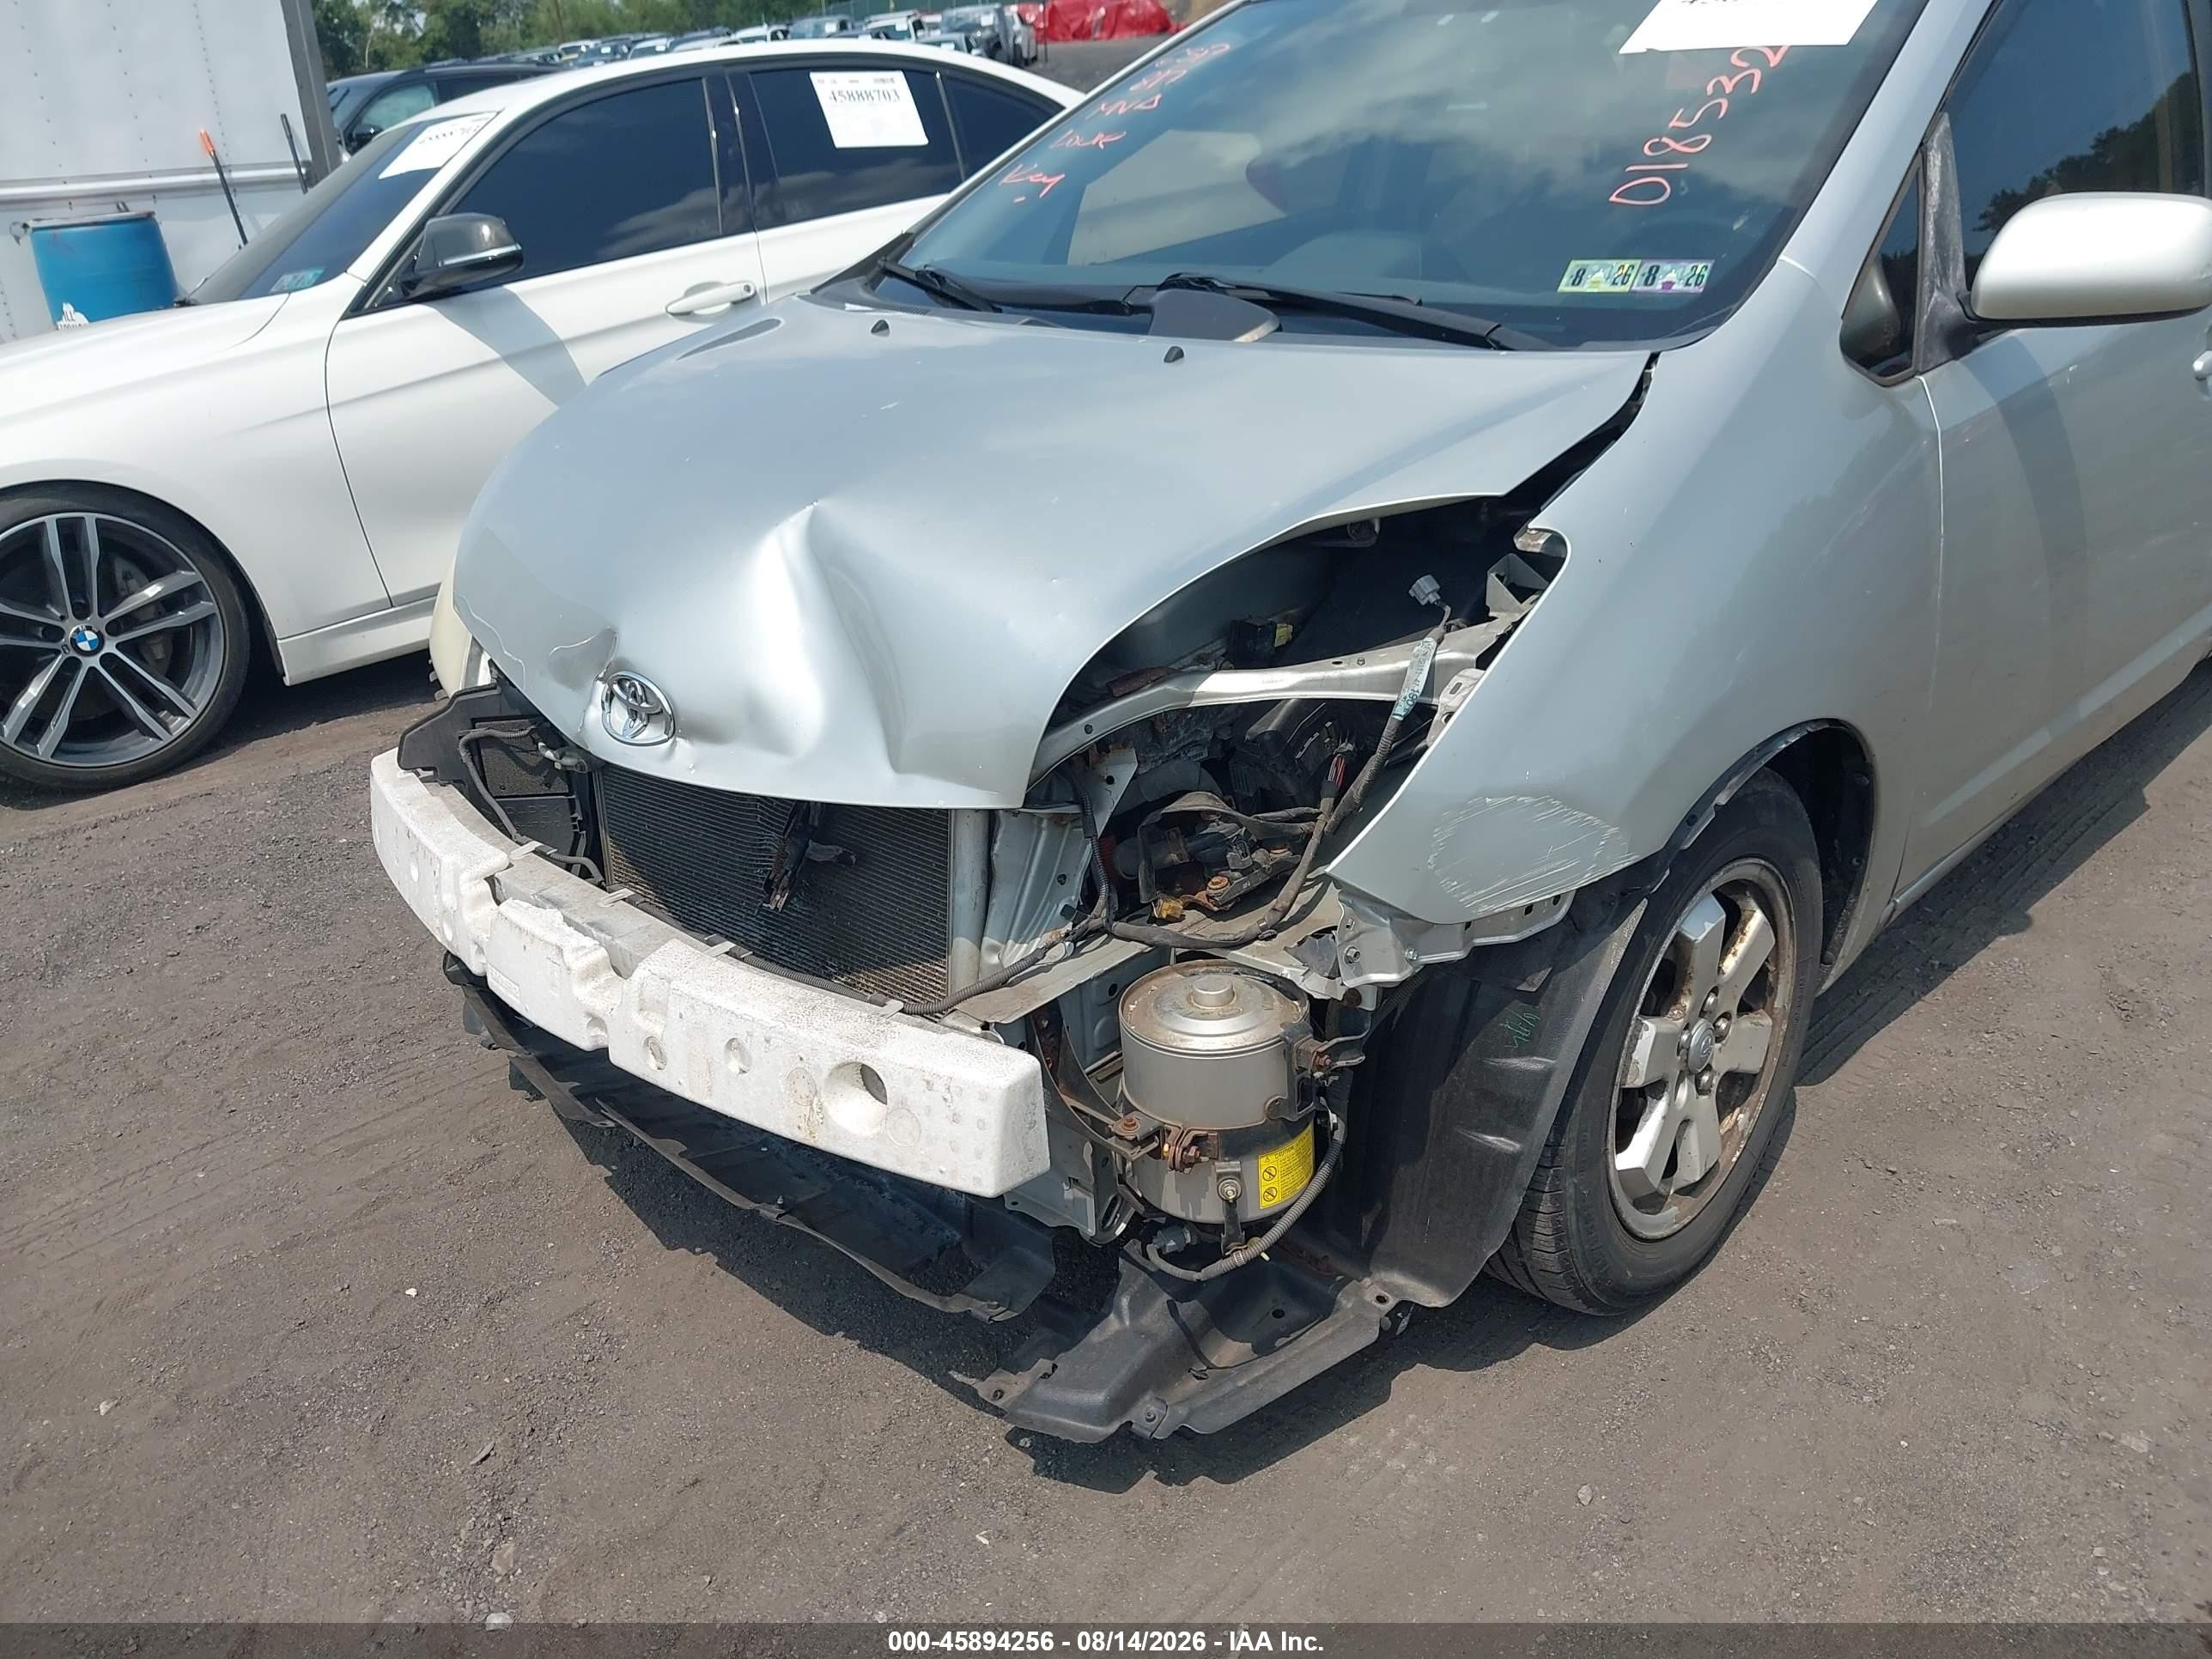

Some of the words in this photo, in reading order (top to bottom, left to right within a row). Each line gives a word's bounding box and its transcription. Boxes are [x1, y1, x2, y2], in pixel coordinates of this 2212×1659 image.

[1608, 46, 1792, 205] 018532
[998, 163, 1066, 199] Key
[1612, 264, 1635, 286] 26
[1685, 264, 1708, 287] 26
